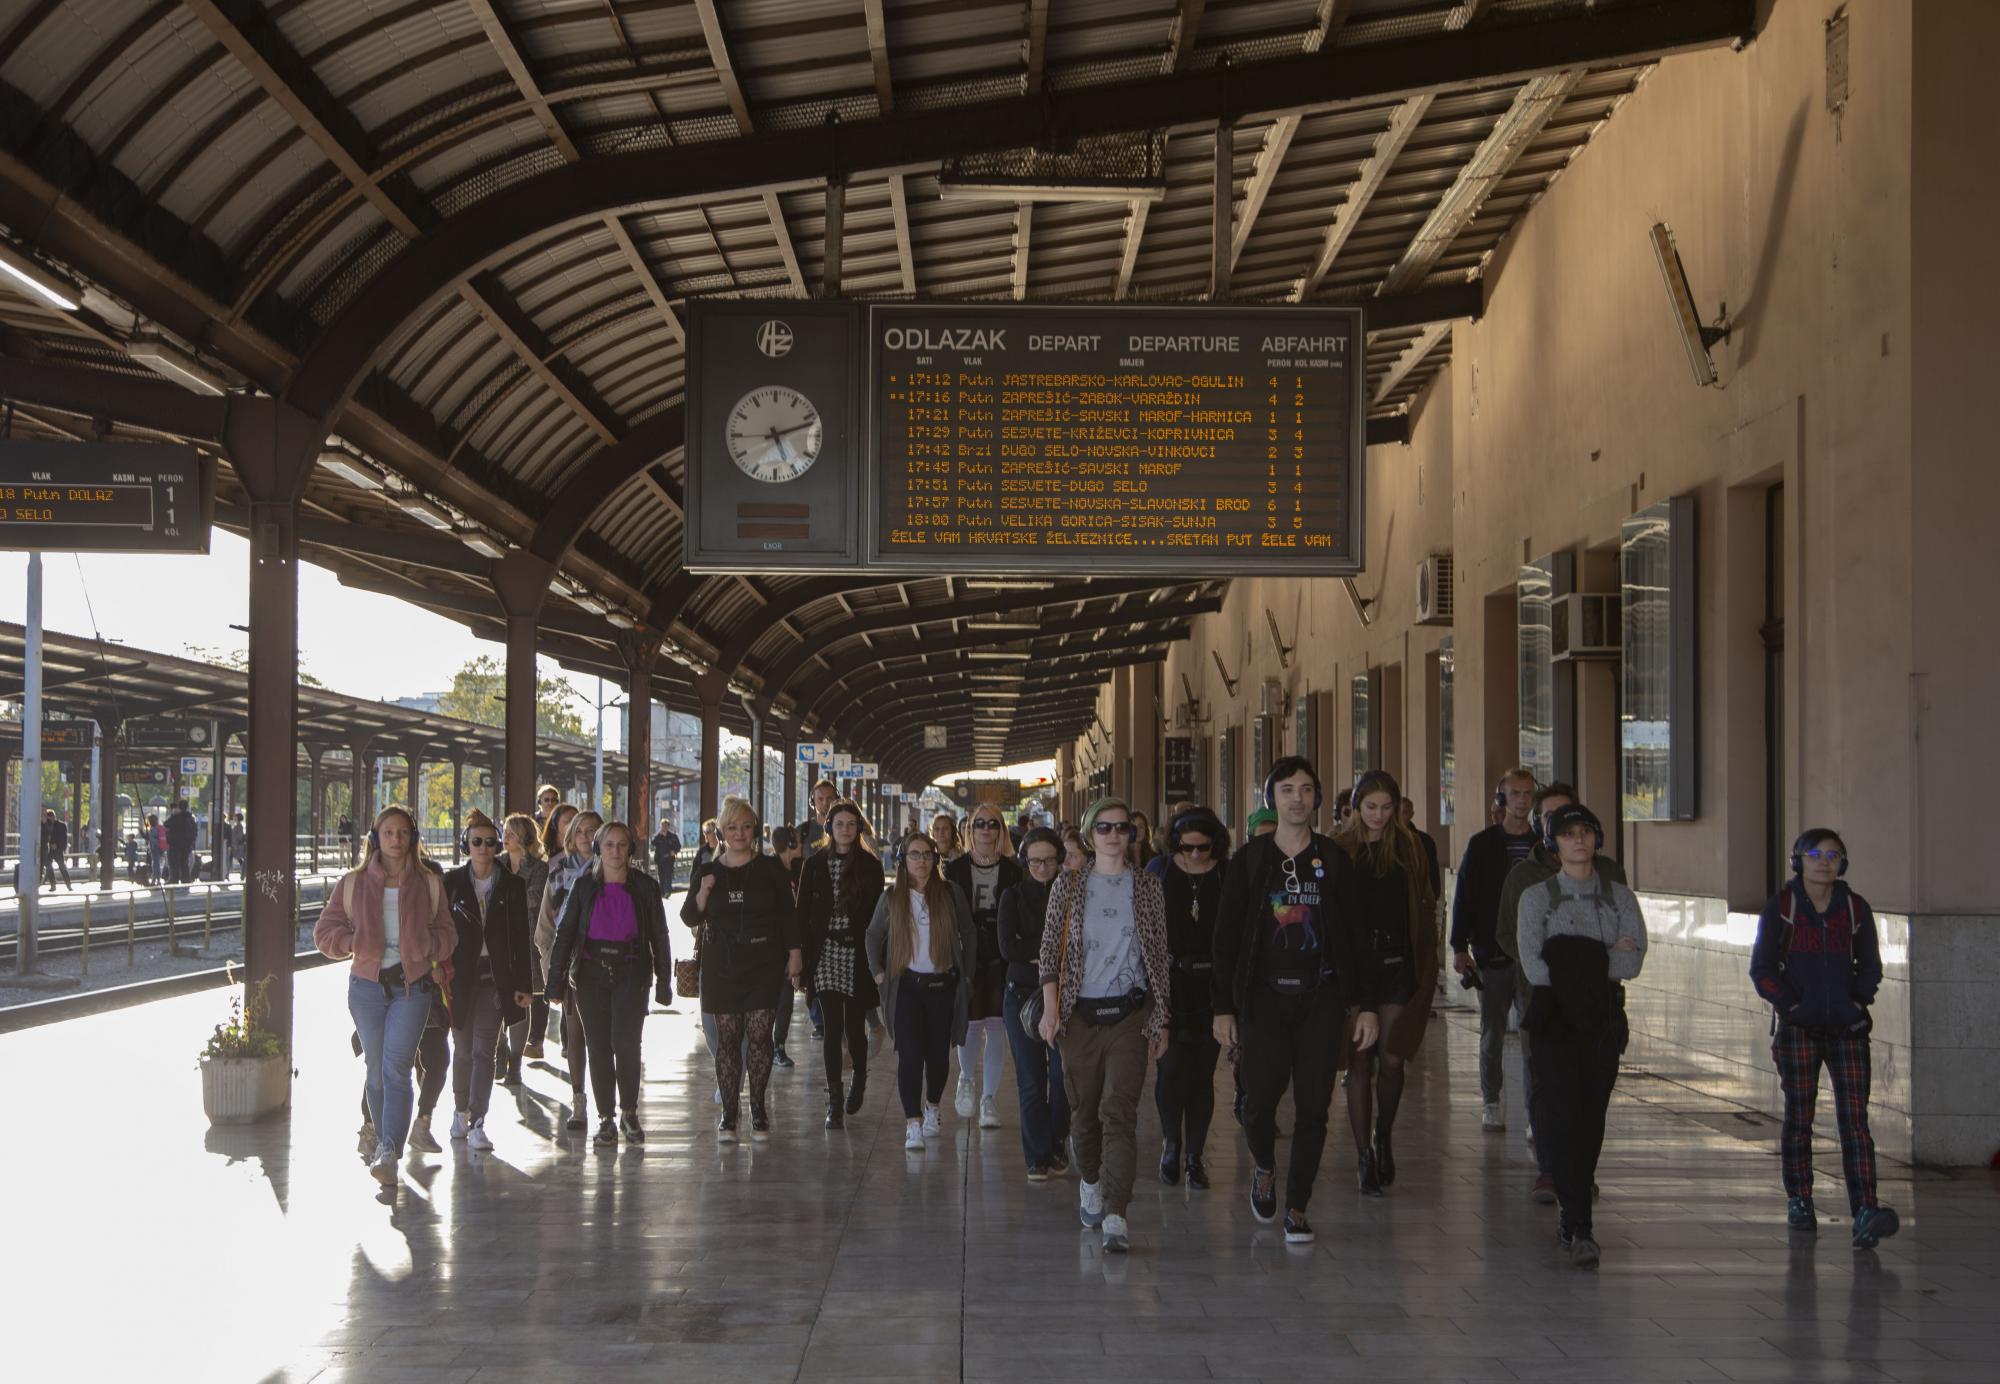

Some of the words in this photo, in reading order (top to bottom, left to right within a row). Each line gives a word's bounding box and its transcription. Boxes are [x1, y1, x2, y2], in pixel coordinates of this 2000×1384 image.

[884, 328, 1007, 351] ODLAZAK
[1028, 335, 1102, 352] DEPART
[1129, 336, 1240, 353] DEPARTURE
[1260, 337, 1347, 354] ABFAHRT
[916, 356, 933, 366] SATI
[963, 357, 983, 366] VLAK
[1119, 358, 1145, 368] SMJER
[1267, 359, 1291, 369] PERON
[1294, 359, 1308, 369] KOL
[908, 373, 951, 386] 17:12
[959, 374, 994, 386] Putn
[1002, 374, 1244, 388] JASTREBARSKO-KARLOVAC-OGULIN
[1268, 377, 1278, 388] 4
[1295, 377, 1303, 388] 1
[908, 391, 951, 404] 17:16
[959, 392, 994, 403] Putn
[1001, 391, 1201, 405] ZAPREŠIĆ-ZABOK-VARAŽDIN
[1268, 394, 1278, 406] 4
[1294, 394, 1305, 406] 2
[907, 408, 949, 420] 17:21
[958, 409, 994, 421] Putn
[1001, 408, 1131, 422] ZAPREŠIĆ-SAVSKI
[1139, 410, 1254, 423] MAROF-HARMICA
[1269, 412, 1277, 423] 1
[1295, 412, 1303, 424] 1
[907, 426, 951, 438] 17:29
[958, 427, 993, 438] Putn
[1001, 426, 1236, 440] SESVETE-KRIŽEVCI-KOPRIVNICA
[1267, 428, 1278, 441] 3
[1294, 429, 1305, 441] 4
[907, 443, 951, 456] 17:42
[958, 444, 993, 456] Brzi
[999, 445, 1037, 456] DUGO
[1044, 444, 1217, 458] SELO-NOVSKA-VINKOVCI
[1267, 447, 1278, 459] 2
[1293, 446, 1305, 459] 3
[907, 461, 951, 473] 17:45
[957, 462, 993, 474] Putn
[1001, 461, 1130, 475] ZAPREŠIĆ-SAVSKI
[1138, 463, 1183, 476] MAROF
[1268, 464, 1277, 476] 1
[1295, 464, 1304, 476] 1
[31, 471, 51, 481] VLAK
[112, 473, 135, 483] KASNI
[157, 473, 184, 483] PERON
[907, 479, 949, 491] 17:51
[956, 479, 993, 492] Putn
[1000, 479, 1105, 493] SESVETE-DUGO
[1112, 480, 1149, 493] SELO
[1267, 482, 1278, 494] 3
[1292, 482, 1303, 494] 4
[23, 488, 61, 500] Putn
[68, 489, 113, 501] DOLAZ
[166, 486, 174, 503] 1
[907, 496, 951, 508] 17:57
[956, 496, 993, 509] Putn
[1000, 497, 1209, 511] SESVETE-NOVSKA-SLAVONSKI
[1214, 498, 1253, 511] BROD
[1266, 499, 1278, 511] 6
[1294, 499, 1302, 512] 1
[15, 508, 53, 520] SELO
[167, 508, 175, 524] 1
[906, 513, 951, 526] 18:00
[956, 514, 993, 526] Putn
[1000, 514, 1053, 527] VELIKA
[1059, 514, 1217, 528] GORICA-SISAK-SUNJA
[1266, 516, 1278, 529] 3
[1291, 516, 1304, 529] 5
[164, 527, 180, 536] KOL
[889, 530, 927, 544] ŽELE
[933, 531, 961, 544] VAM
[967, 531, 1039, 544] HRVATSKE
[1225, 533, 1254, 546] PUT
[1260, 533, 1297, 547] ŽELE
[1303, 534, 1332, 547] VAM
[201, 760, 208, 771] 2
[1304, 882, 1320, 893] DEE
